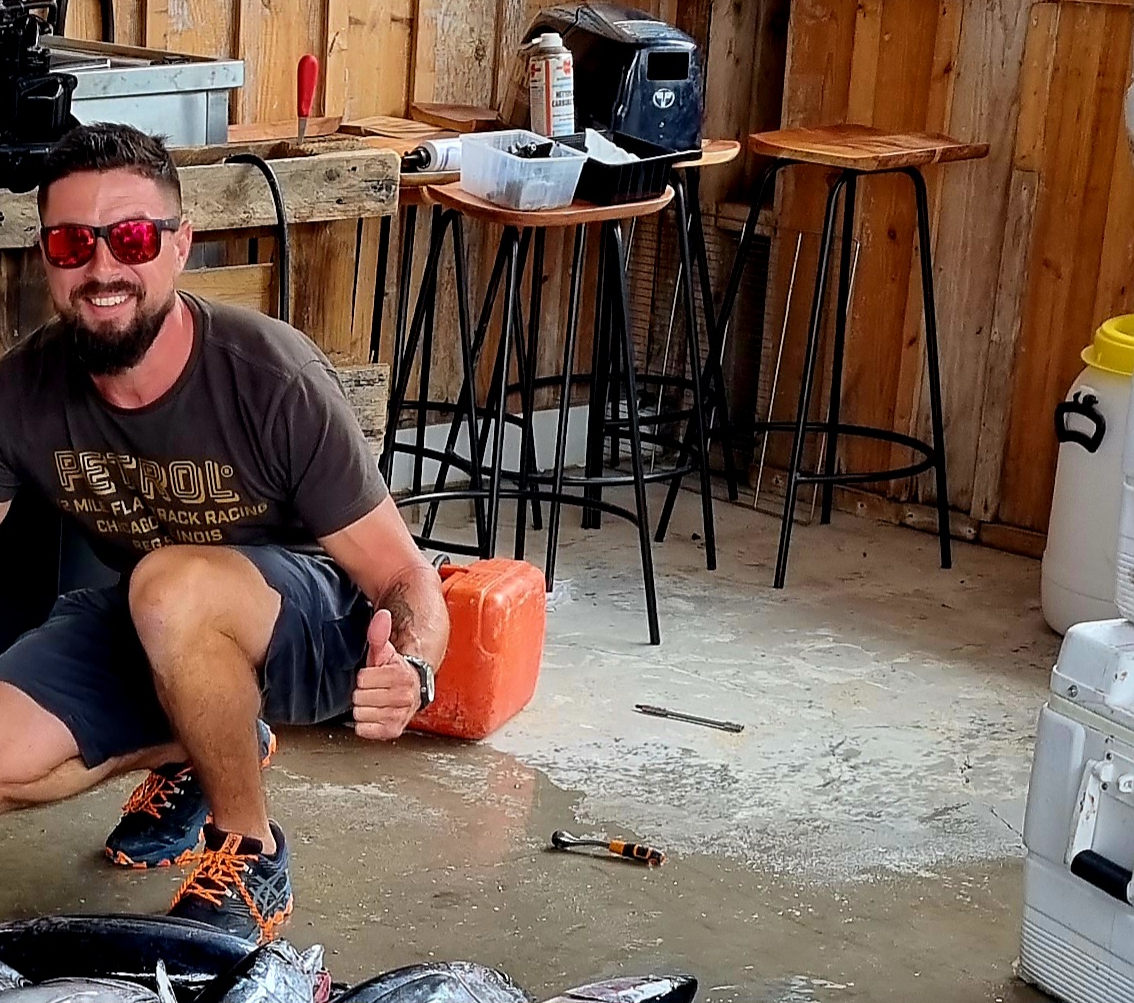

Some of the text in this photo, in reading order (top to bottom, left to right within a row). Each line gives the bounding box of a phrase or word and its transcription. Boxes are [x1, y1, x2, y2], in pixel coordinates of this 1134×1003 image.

[110, 496, 145, 516] FLA
[154, 507, 202, 526] RACK
[204, 502, 269, 526] RACING
